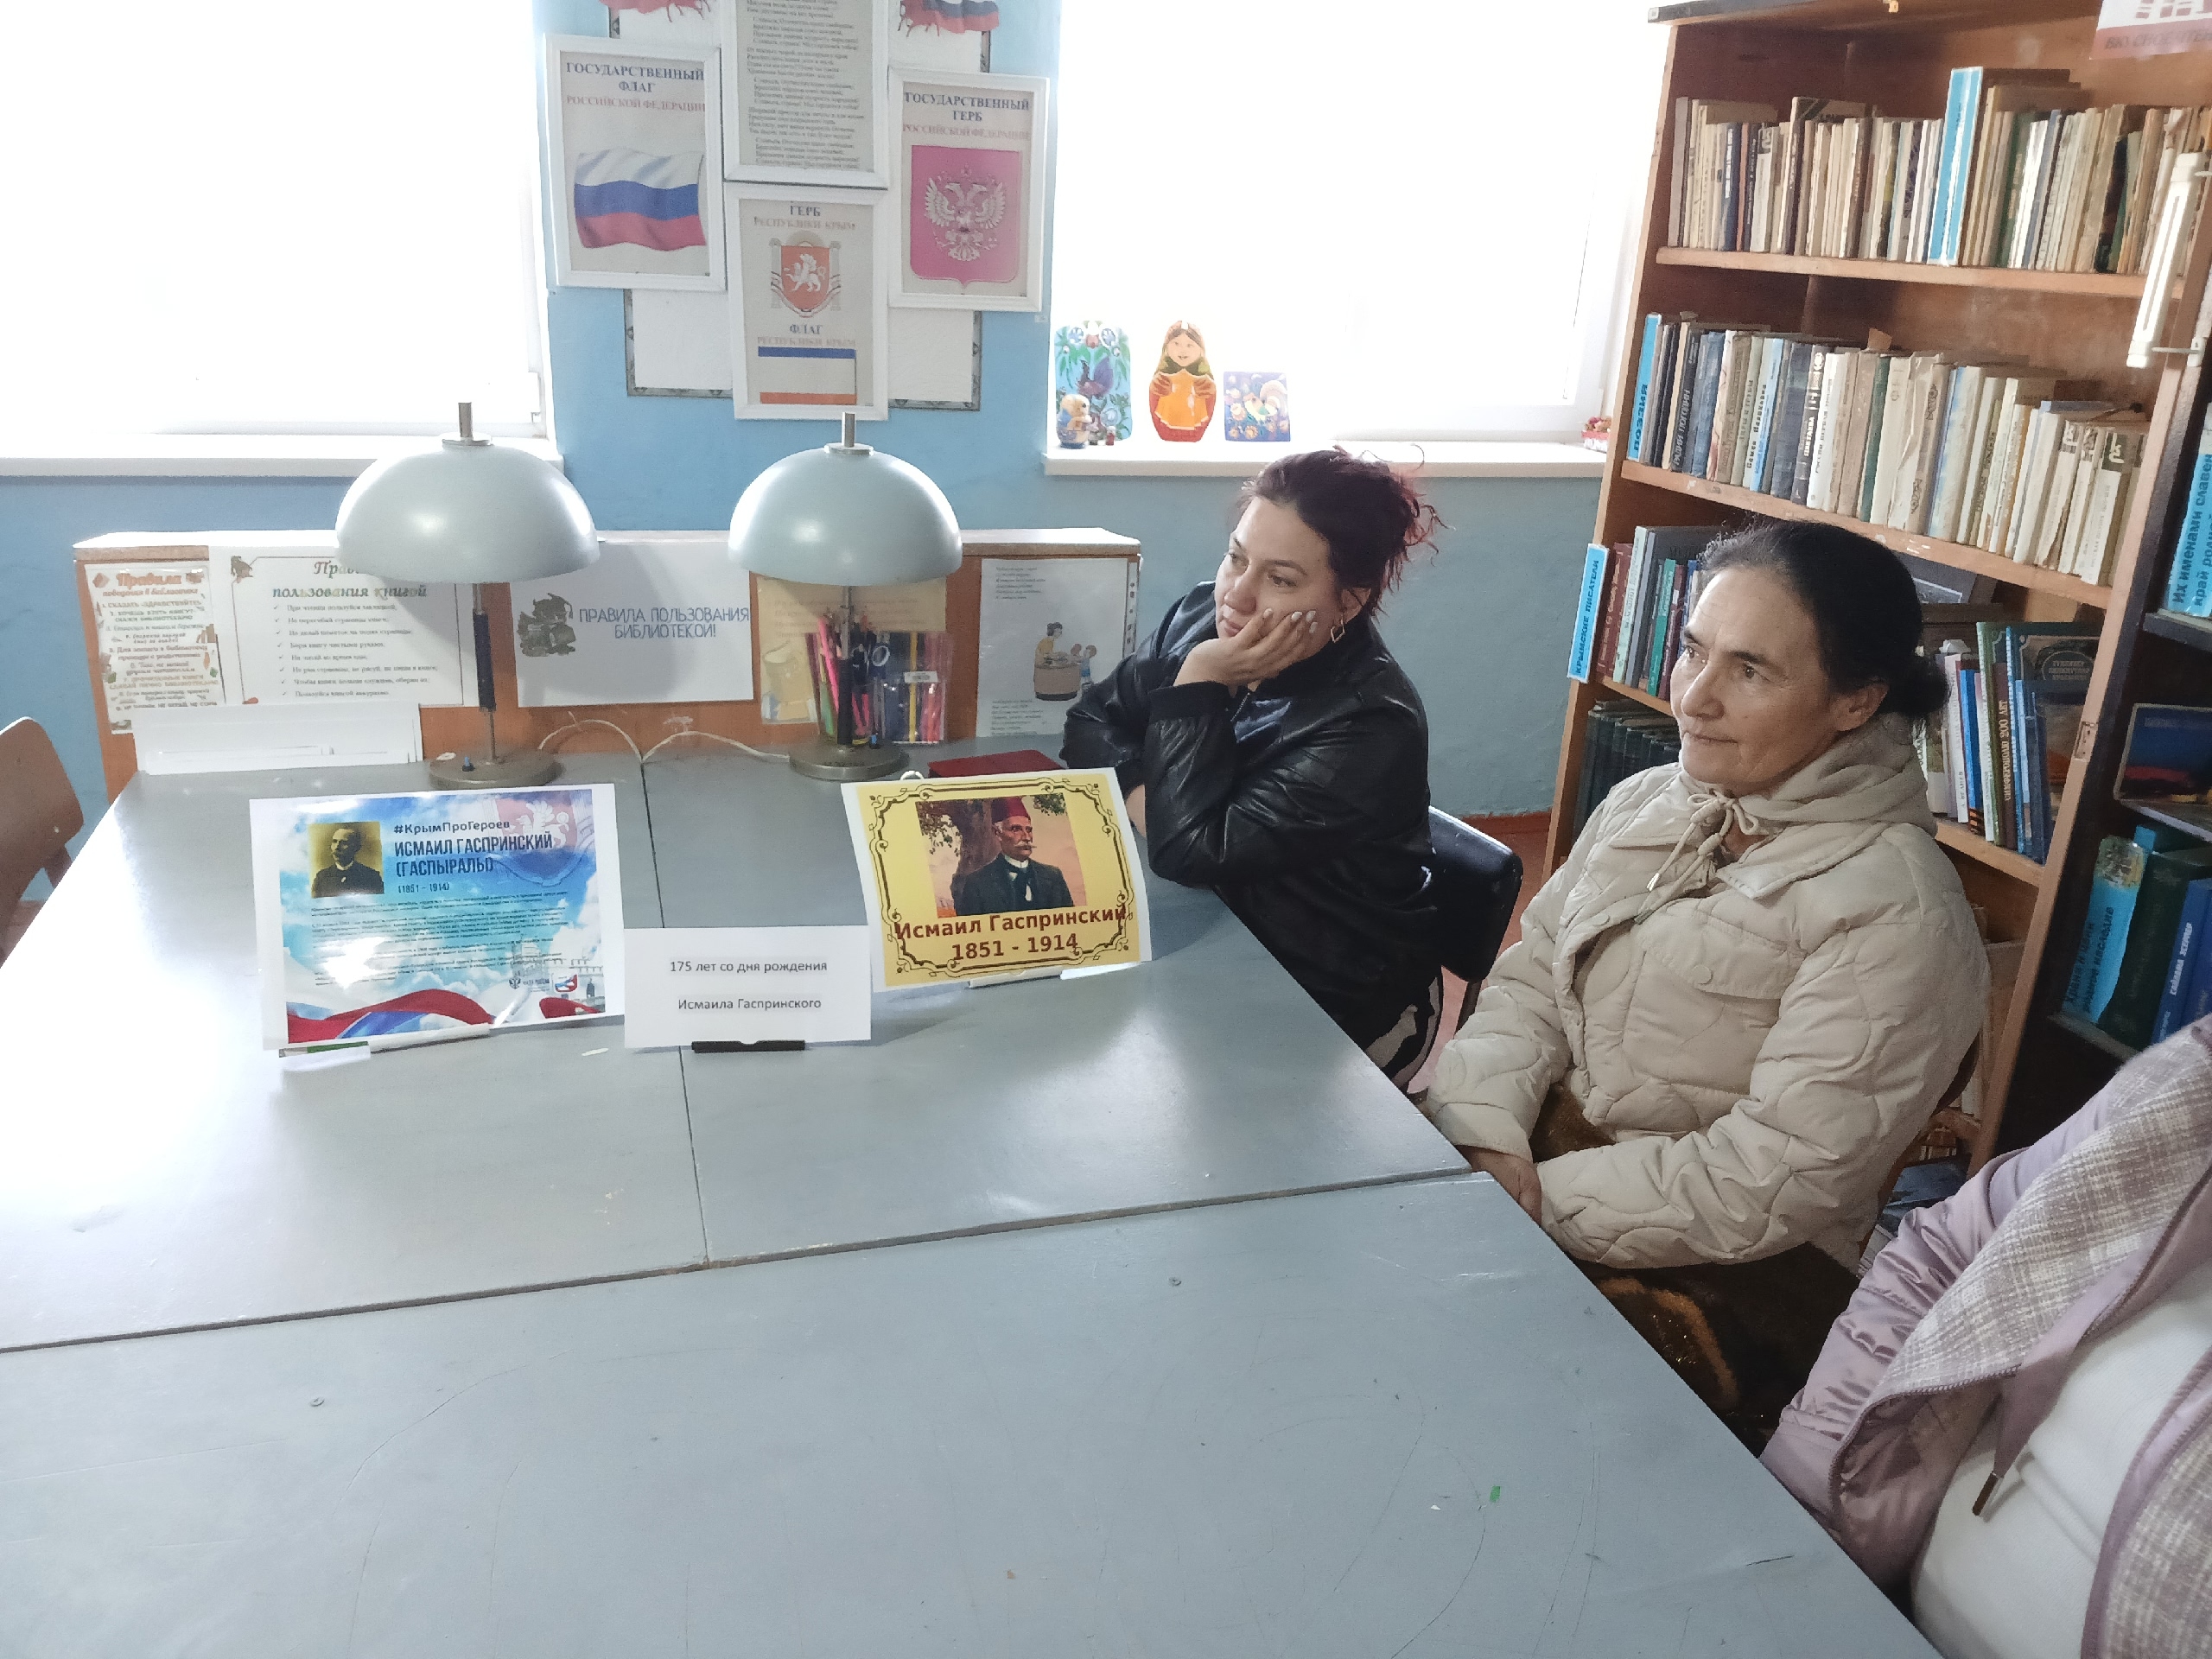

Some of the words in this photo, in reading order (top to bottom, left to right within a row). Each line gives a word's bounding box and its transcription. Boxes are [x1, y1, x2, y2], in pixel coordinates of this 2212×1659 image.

[566, 62, 704, 80] ГОСУДАРСТВЕННЫЙ
[619, 80, 656, 92] ФЛАГ
[905, 92, 1029, 111] ГОСУДАРСТВЕННЫЙ
[952, 110, 982, 122] ГЕРБ
[790, 206, 821, 216] ГЕРБ
[789, 324, 823, 334] ФЛАГ
[1634, 384, 1649, 451] ПОЭЗИЯ
[2179, 511, 2202, 581] именами
[116, 572, 182, 590] Правила
[2194, 571, 2209, 607] край
[272, 588, 369, 598] пользования
[374, 584, 427, 601] книгой
[2172, 583, 2189, 604] Их
[579, 608, 645, 623] ПРАВИЛА
[651, 607, 749, 623] ПОЛЬЗОВАНИЯ
[1575, 616, 1590, 674] КРЫМСКИЕ
[1586, 560, 1599, 612] ПИСАТЕЛИ
[1998, 700, 2008, 715] ЛЕТ
[1999, 719, 2010, 738] 200
[2001, 741, 2012, 802] СИМФЕРОПОЛЮ
[393, 821, 510, 836] #КрымПроГероев
[394, 839, 453, 857] ИСМАИЛ
[457, 831, 553, 854] ГАСПРИНСКИЙ
[894, 920, 982, 940] Исмаил
[989, 906, 1127, 932] Гаспринский
[951, 940, 1004, 961] 1851
[1027, 932, 1078, 953] 1914
[670, 961, 691, 972] 175
[696, 963, 716, 972] лет
[720, 963, 734, 971] со
[736, 963, 760, 974] дня
[764, 962, 827, 974] рождения
[678, 999, 734, 1009] Исмаила
[738, 999, 821, 1011] Гаспринского
